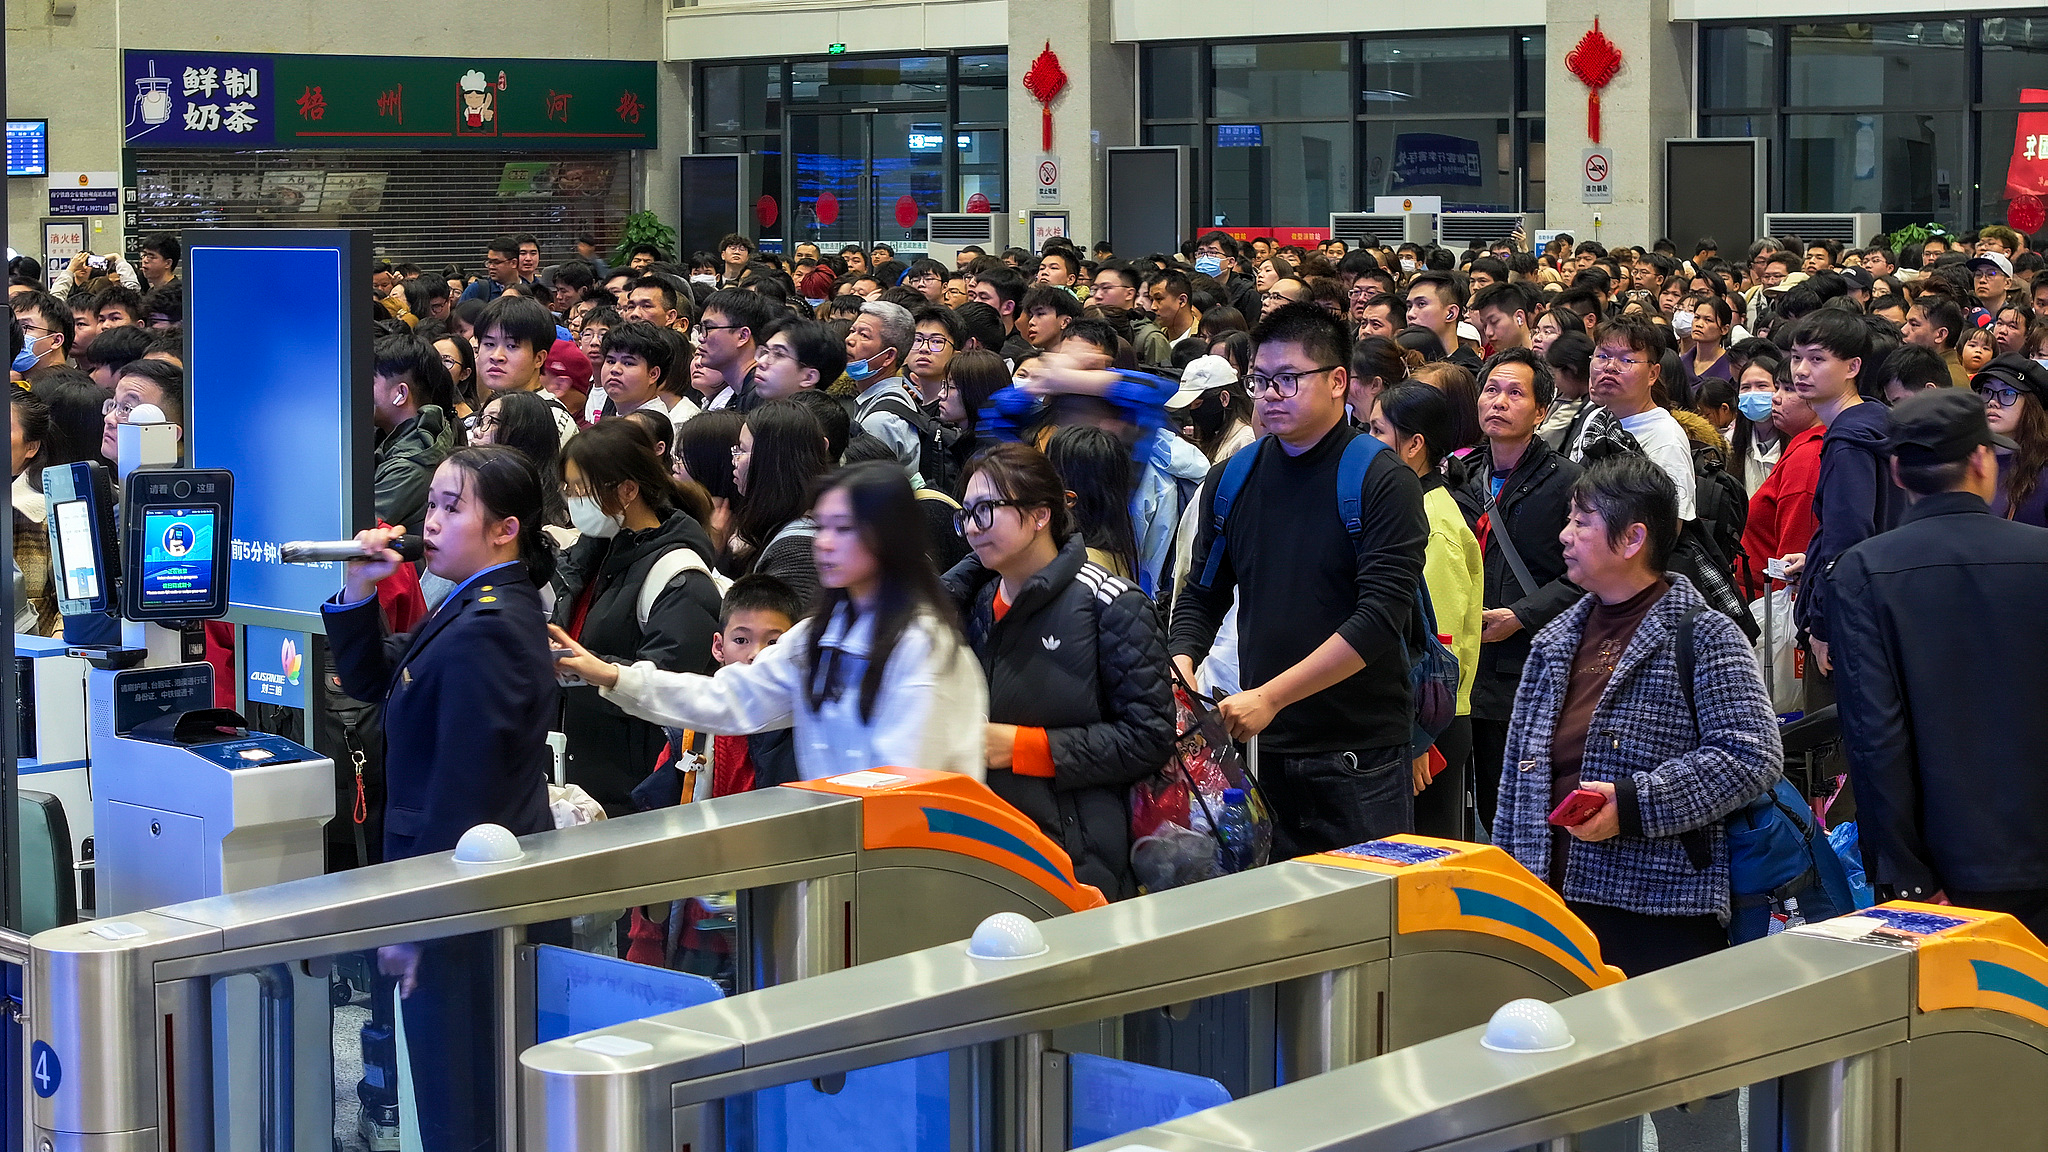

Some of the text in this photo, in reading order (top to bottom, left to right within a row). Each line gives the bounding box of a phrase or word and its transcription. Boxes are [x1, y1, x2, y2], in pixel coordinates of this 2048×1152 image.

[182, 66, 259, 98] 鲜制
[182, 101, 259, 133] 奶茶
[50, 233, 81, 245] 消火栓
[1036, 226, 1062, 238] 消火栓
[149, 483, 215, 495] 请看 这里
[260, 683, 283, 697] 刘三姐
[35, 1050, 51, 1090] 4
